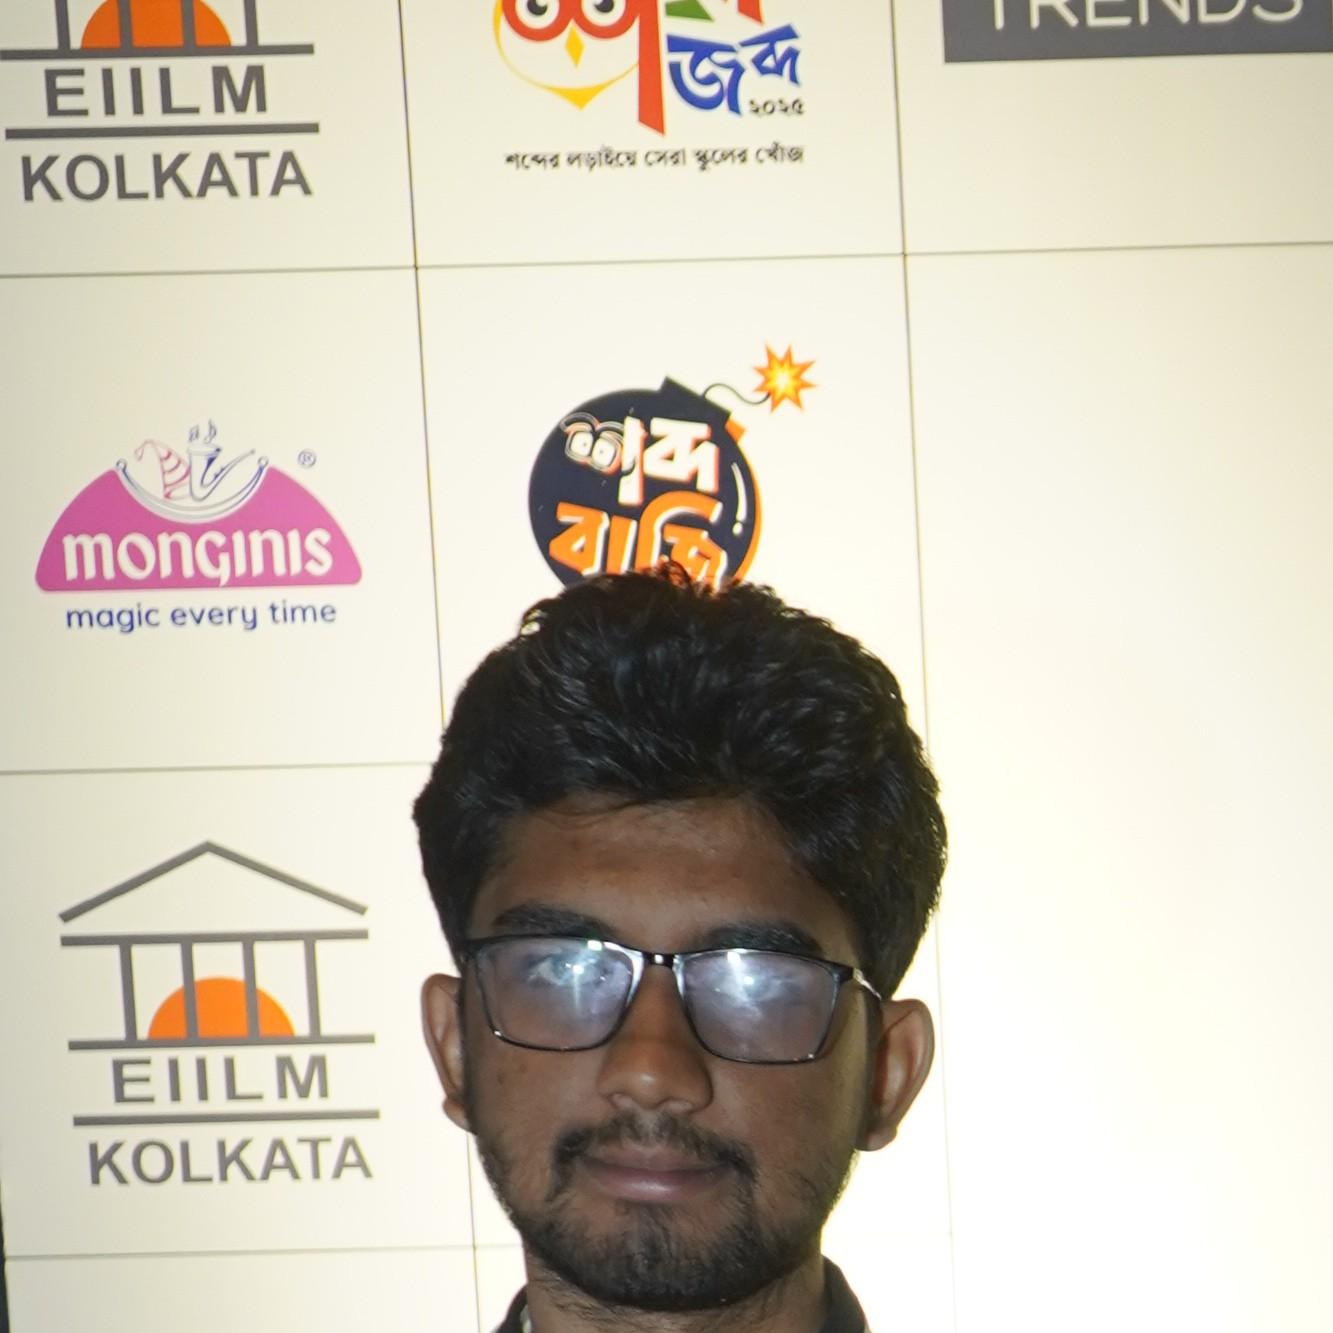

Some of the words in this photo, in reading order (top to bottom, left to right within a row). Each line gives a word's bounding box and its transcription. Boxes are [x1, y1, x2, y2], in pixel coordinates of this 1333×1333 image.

[44, 65, 268, 117] EIILM
[667, 24, 800, 116] জব্দ
[21, 150, 313, 203] KOLKATA
[65, 603, 161, 634] magic
[171, 602, 259, 634] every
[269, 601, 337, 624] time
[112, 1053, 330, 1105] EIILM
[89, 1136, 373, 1186] KOLKATA
